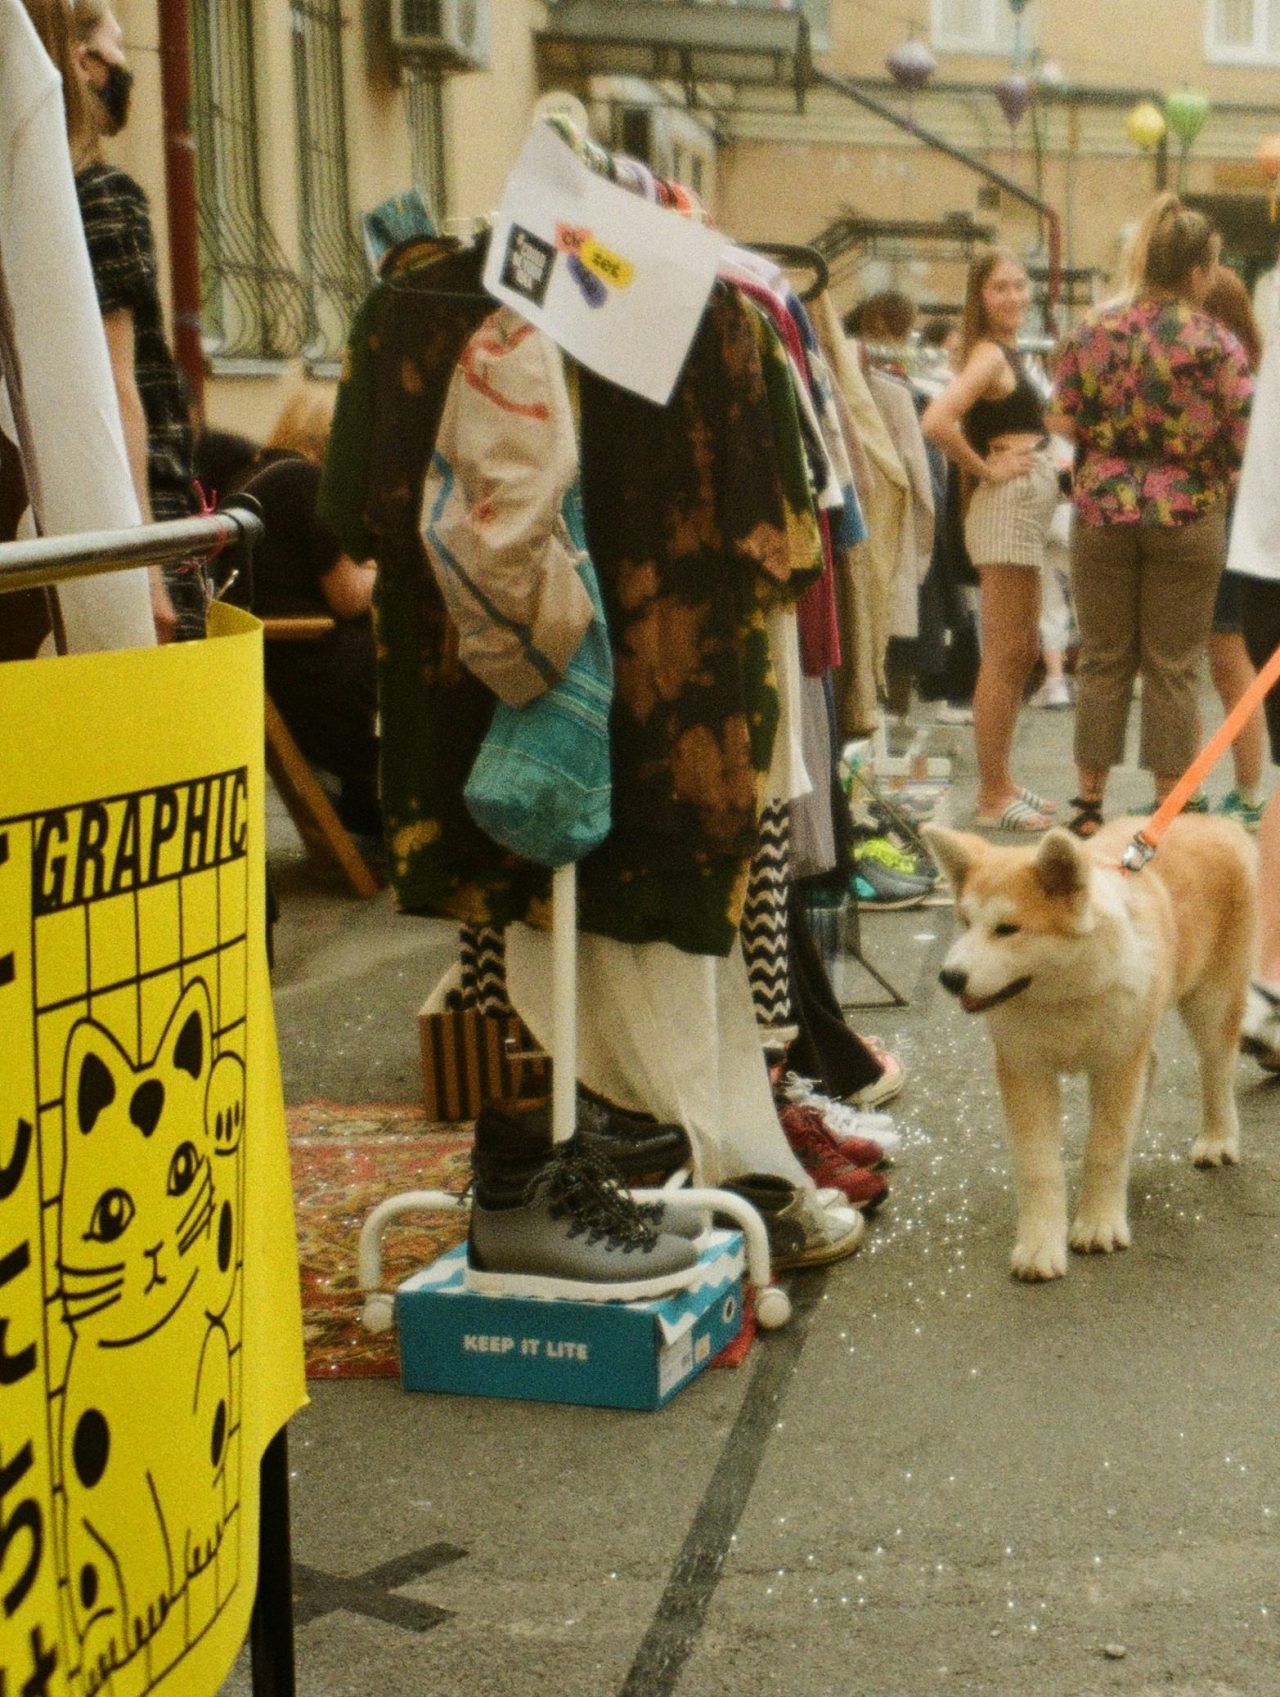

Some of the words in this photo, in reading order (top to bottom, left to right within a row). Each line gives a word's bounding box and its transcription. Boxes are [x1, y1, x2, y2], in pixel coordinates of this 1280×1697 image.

[35, 769, 247, 912] GRAPHIC
[463, 1335, 514, 1353] KEEP
[521, 1338, 539, 1356] IT
[546, 1341, 588, 1360] LITE
